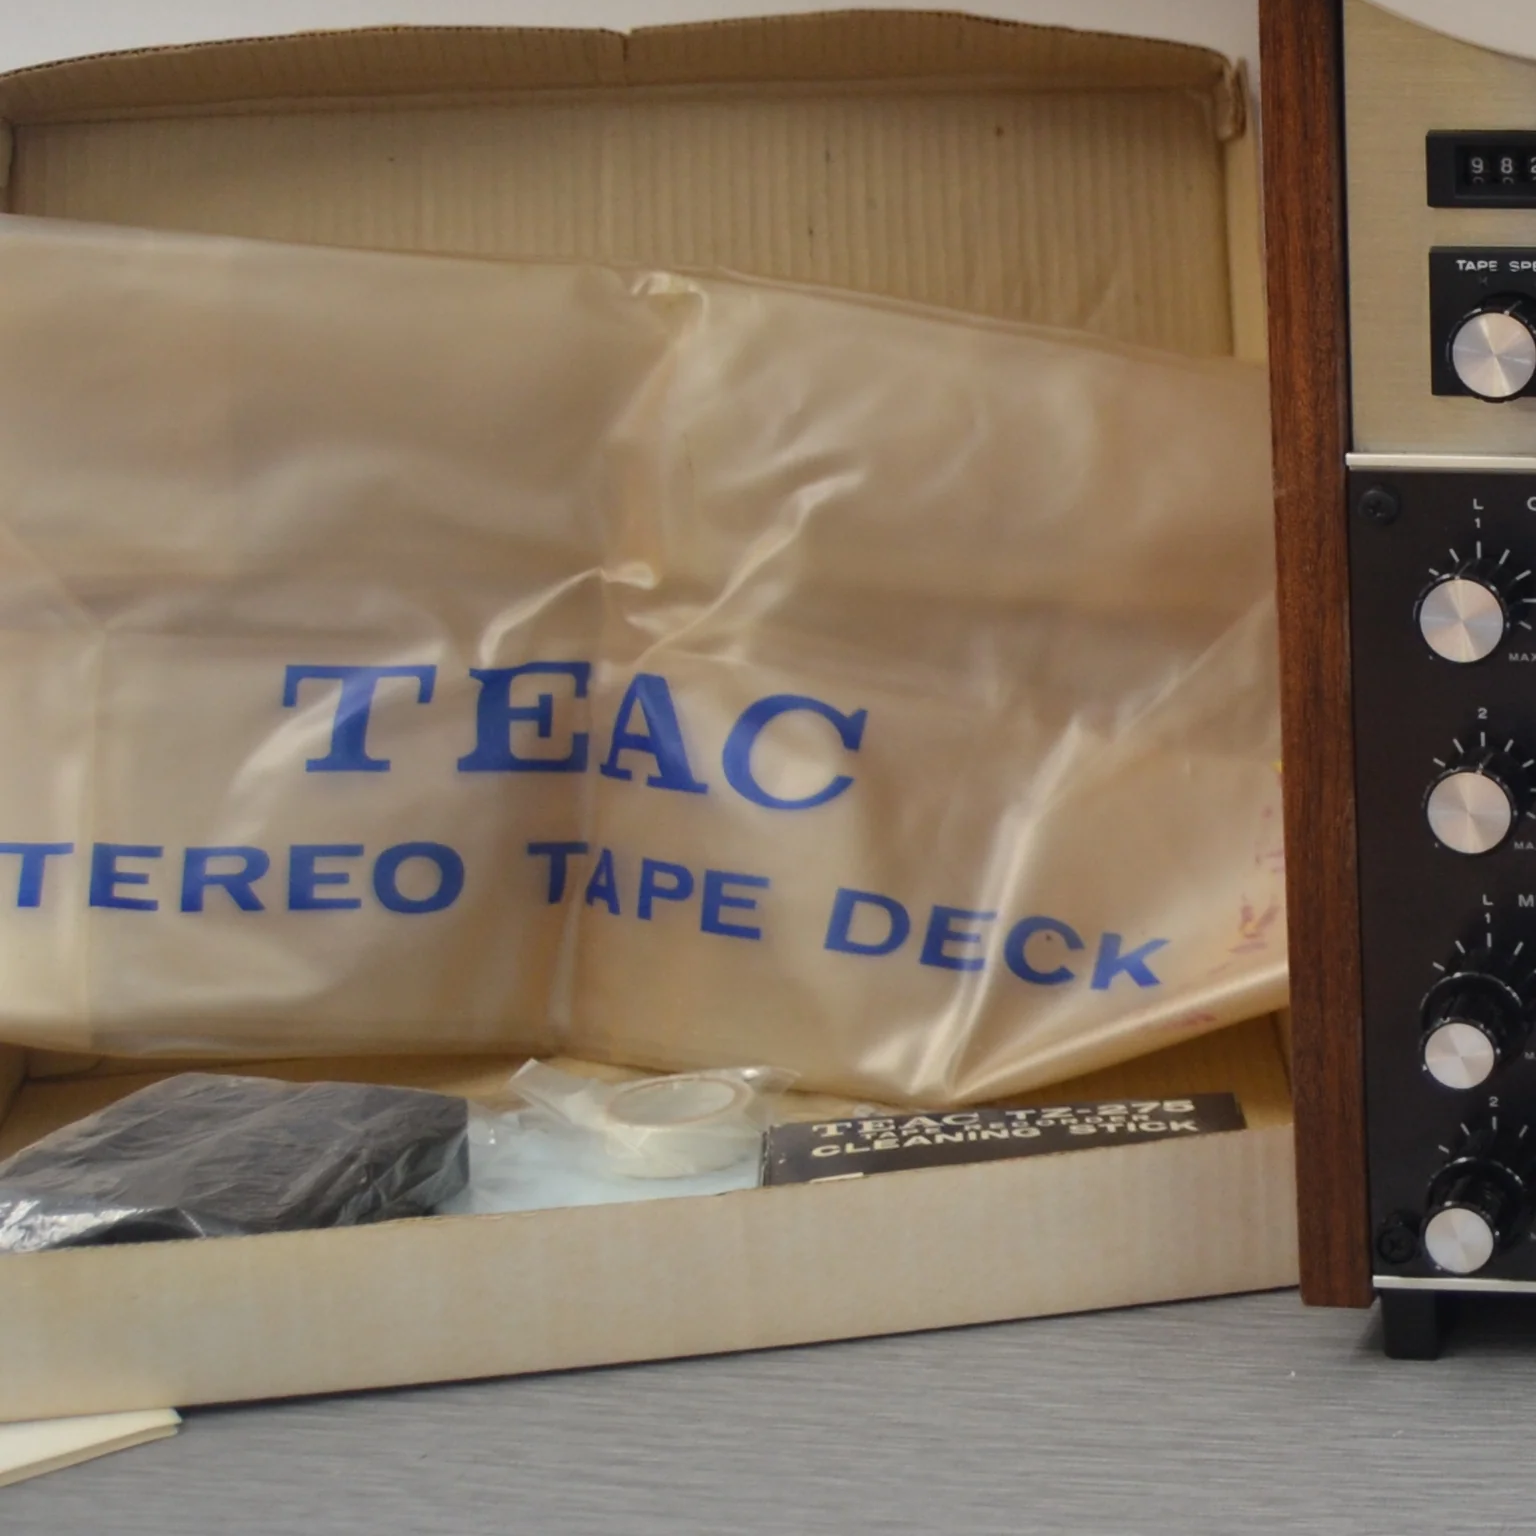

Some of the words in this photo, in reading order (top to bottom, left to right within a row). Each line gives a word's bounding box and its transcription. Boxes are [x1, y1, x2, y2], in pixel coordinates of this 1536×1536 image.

[1456, 259, 1498, 272] TAPE
[1473, 498, 1484, 510] L
[280, 660, 869, 811] TEAC
[528, 842, 771, 942] TAPE
[822, 887, 1173, 993] DECK
[812, 1112, 981, 1138] TEAC
[1006, 1099, 1195, 1122] TZ-275
[964, 1114, 1150, 1131] RECORDER
[811, 1127, 1041, 1159] CLEANING
[1069, 1119, 1199, 1137] STICK
